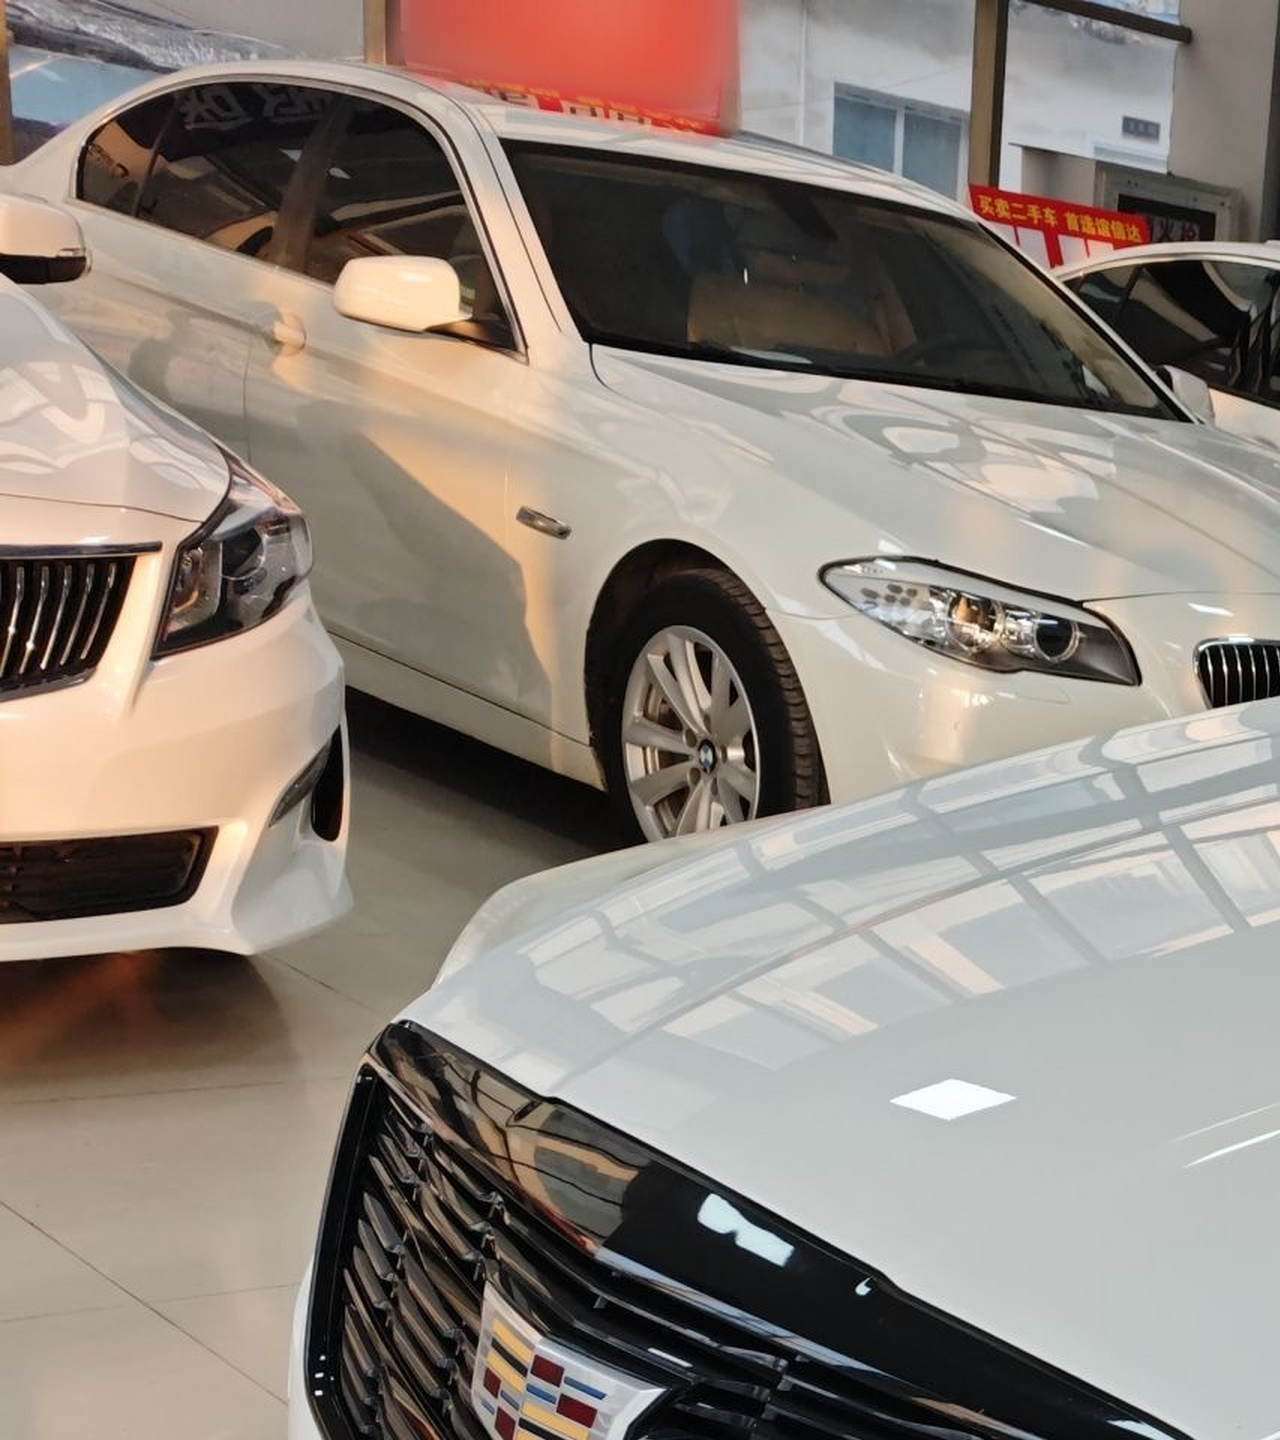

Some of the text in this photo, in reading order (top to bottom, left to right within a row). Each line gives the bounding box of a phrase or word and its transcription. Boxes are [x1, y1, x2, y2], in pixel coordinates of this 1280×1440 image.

[977, 194, 1058, 228] 买卖二手车
